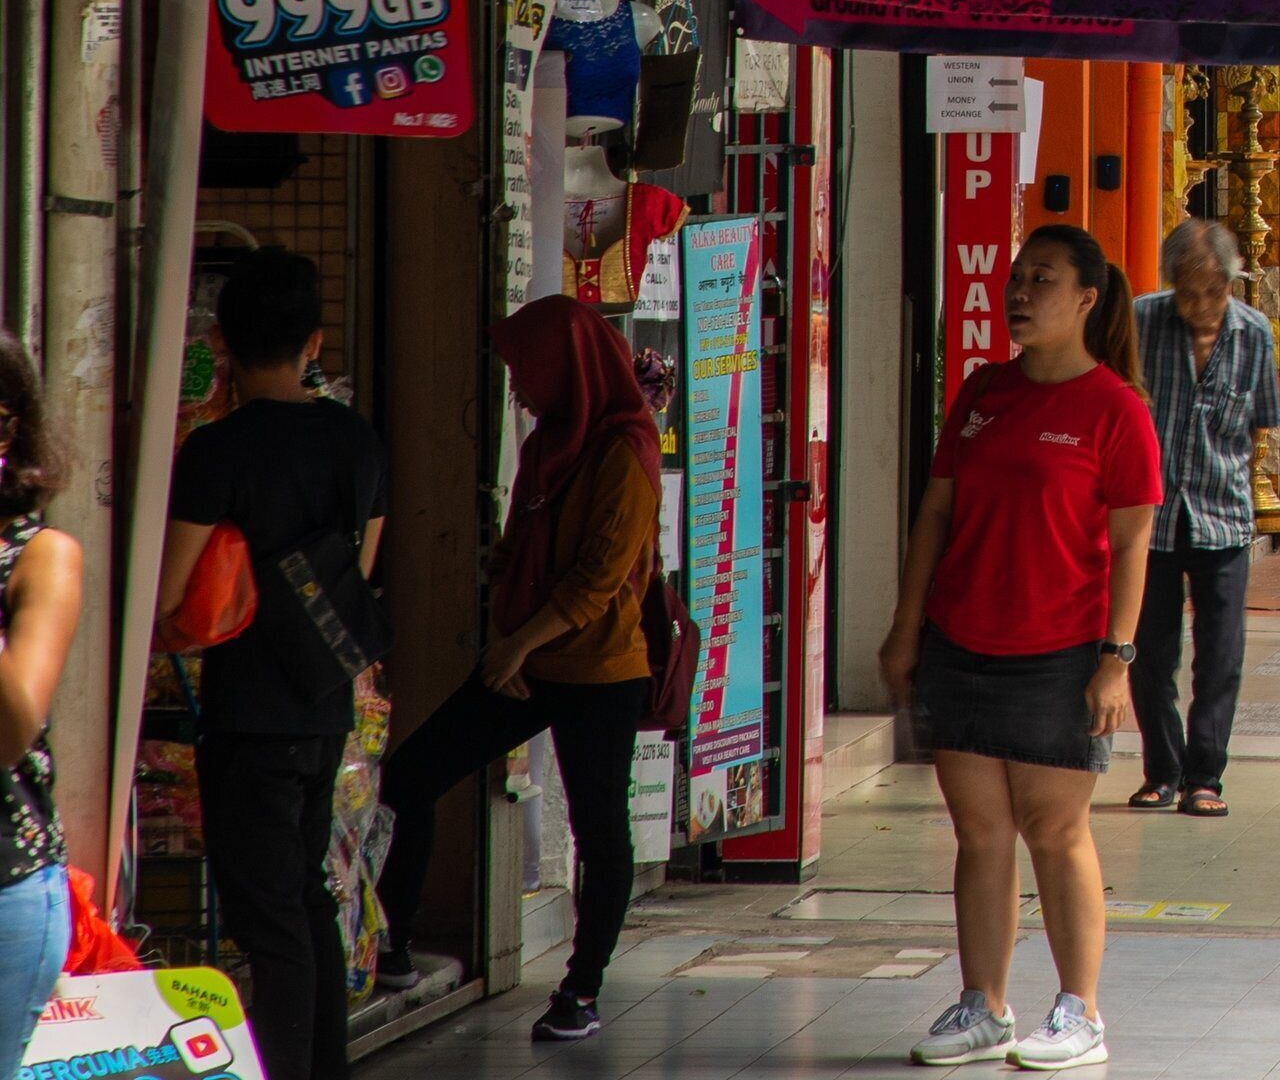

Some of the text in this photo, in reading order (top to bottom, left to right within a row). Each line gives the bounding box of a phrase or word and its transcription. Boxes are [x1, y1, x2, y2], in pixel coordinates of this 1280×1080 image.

[244, 31, 448, 79] INTERNET PANTAS
[944, 62, 980, 70] WESTERN
[947, 76, 974, 84] UNION
[947, 96, 976, 104] MONEY
[941, 110, 982, 118] EXCHANGE
[691, 226, 755, 249] ALKA BEAUTY
[710, 253, 735, 271] CARE
[693, 350, 758, 380] OUR SERVICES
[171, 980, 228, 1007] BAHARU
